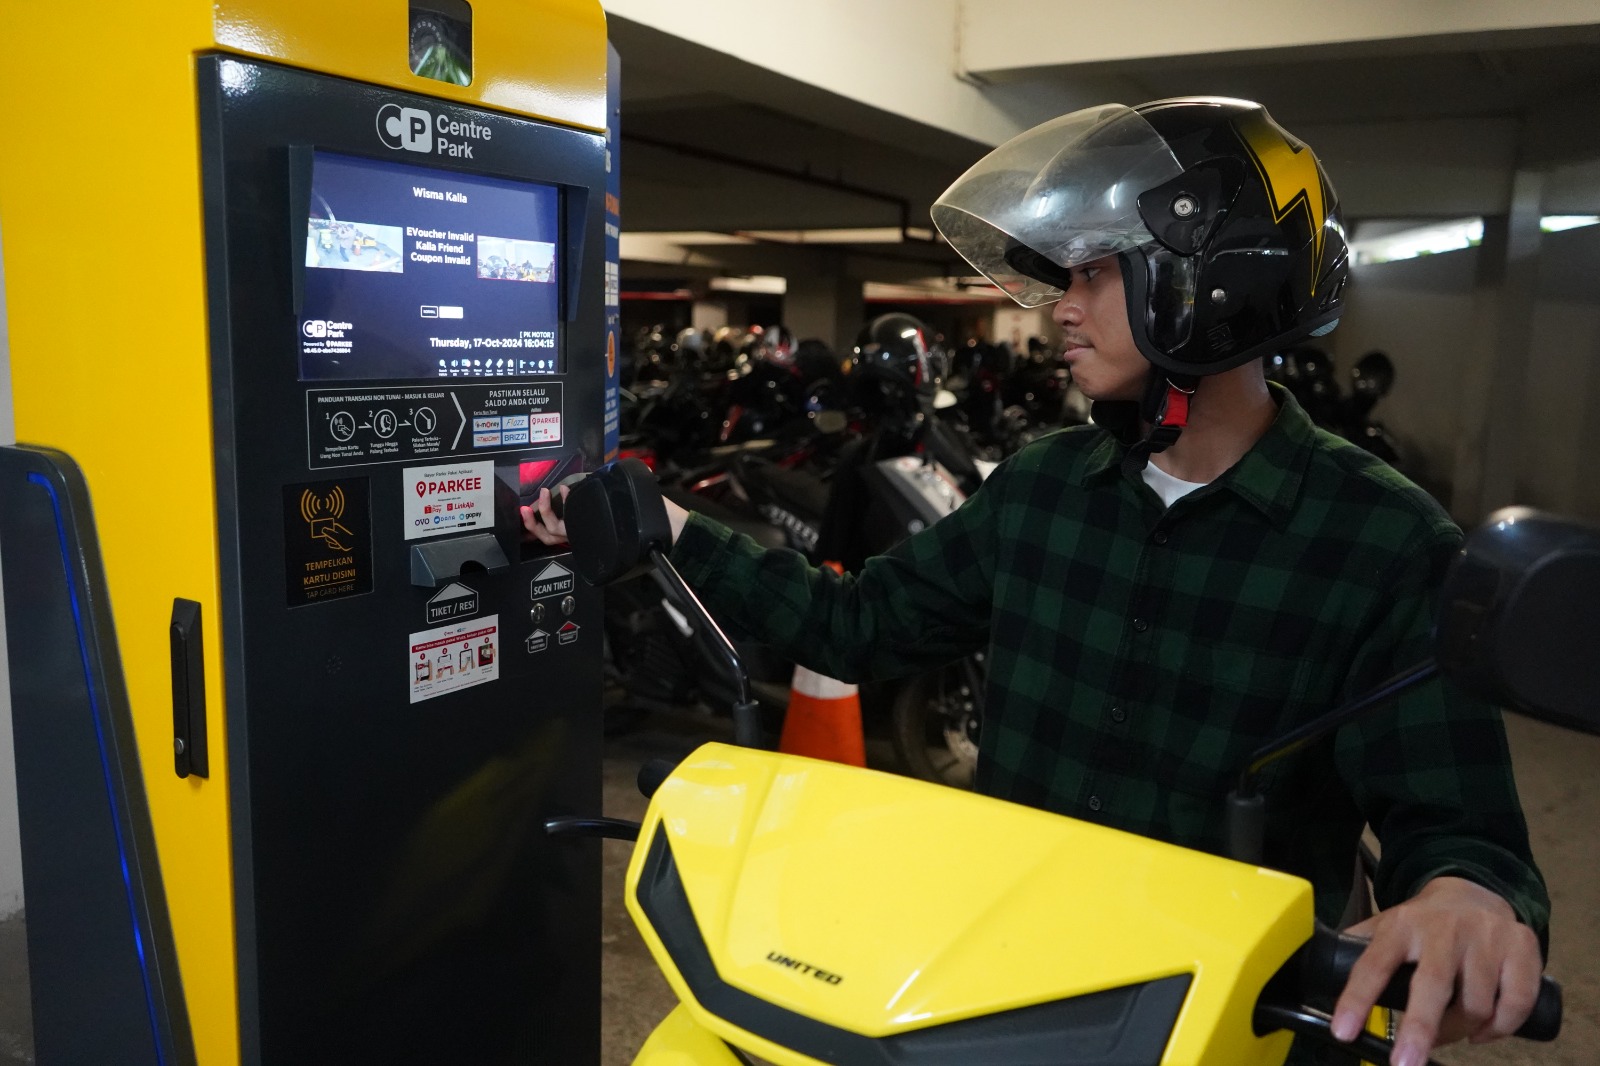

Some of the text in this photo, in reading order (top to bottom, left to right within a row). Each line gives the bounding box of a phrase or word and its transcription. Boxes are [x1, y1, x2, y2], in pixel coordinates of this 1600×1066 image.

[436, 114, 492, 141] Centre
[437, 138, 474, 159] Park
[412, 186, 468, 203] Wisma Kalla
[406, 226, 474, 242] EVoucher Invalid
[415, 240, 464, 254] Kalla Friend
[410, 251, 471, 266] Coupon Invalid
[326, 320, 353, 330] Centre
[327, 329, 345, 338] Park
[523, 331, 532, 339] PK
[531, 331, 551, 339] MOTOR
[330, 340, 353, 348] PARKEE
[429, 337, 555, 350] Thursday, 17-Oct-2024 16:04:15
[489, 388, 546, 398] PASTIKAN SELALU
[484, 397, 550, 408] SALDO ANDA CUKUP
[325, 412, 330, 420] 1
[368, 410, 374, 418] 2
[408, 408, 414, 416] 3
[536, 416, 559, 424] PARKEE
[504, 433, 527, 442] BRIZZI
[428, 477, 482, 495] PARKEE
[414, 517, 430, 526] OVO
[465, 511, 482, 520] gopay
[305, 556, 353, 571] TEMPELKAN
[303, 568, 356, 585] KARTU DISINI
[306, 583, 355, 599] TAP CARD HERE
[533, 579, 571, 595] SCAN TIKET
[430, 605, 452, 618] TIKET
[459, 600, 475, 612] RESI
[766, 951, 843, 986] UNITED
